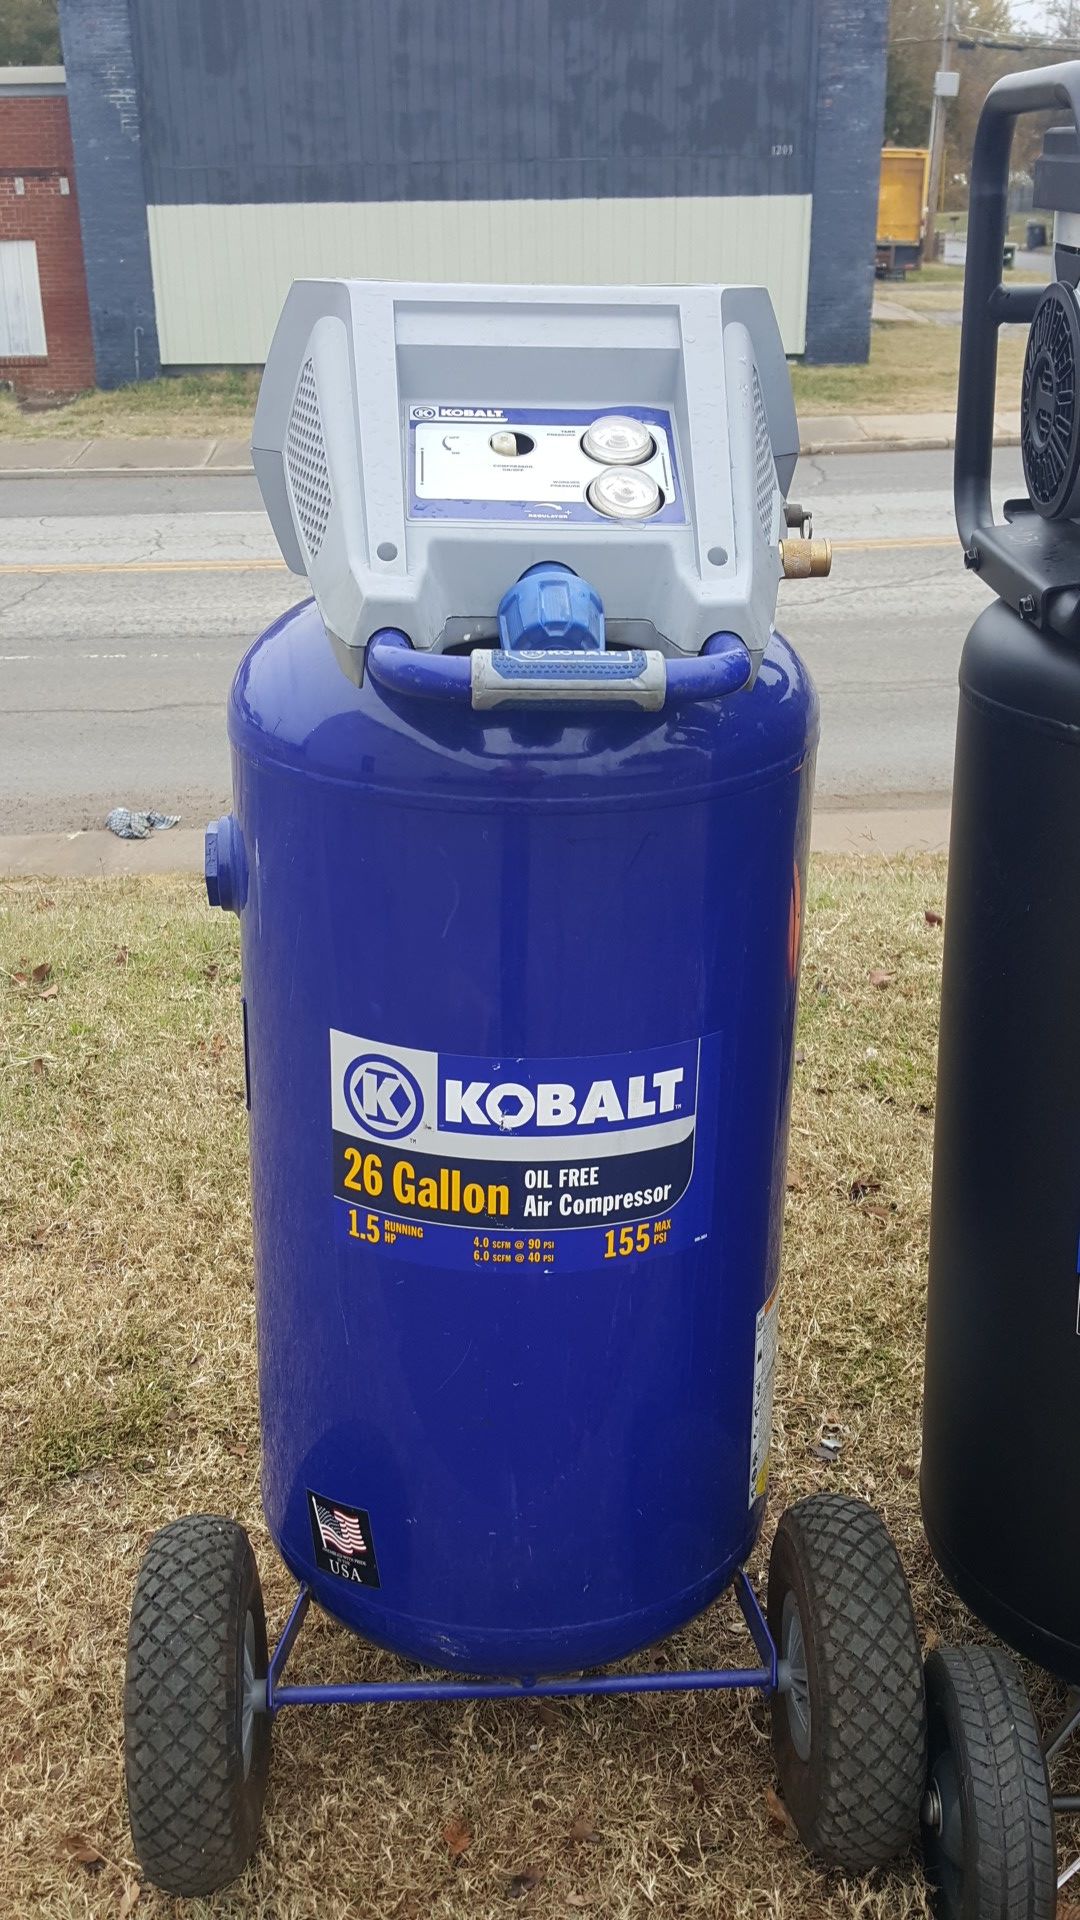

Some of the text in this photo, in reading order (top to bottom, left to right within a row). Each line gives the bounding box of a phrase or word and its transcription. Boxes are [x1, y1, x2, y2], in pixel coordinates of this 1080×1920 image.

[440, 409, 503, 417] KOBALT
[445, 1067, 684, 1128] KOBALT
[344, 1147, 510, 1216] 26 Gallon
[524, 1166, 600, 1189] OIL FREE
[523, 1184, 672, 1217] Air Compressor
[348, 1209, 380, 1243] 1.5
[384, 1219, 424, 1239] RUNNING
[654, 1219, 672, 1233] MAX
[384, 1232, 397, 1244] HP
[473, 1236, 555, 1250] 4.0 SCFM @ 90 PSI
[604, 1222, 650, 1259] 155
[653, 1231, 667, 1245] PSI
[473, 1250, 555, 1263] 6.0 SCFM @ 40 PSI
[329, 1559, 363, 1583] USA
